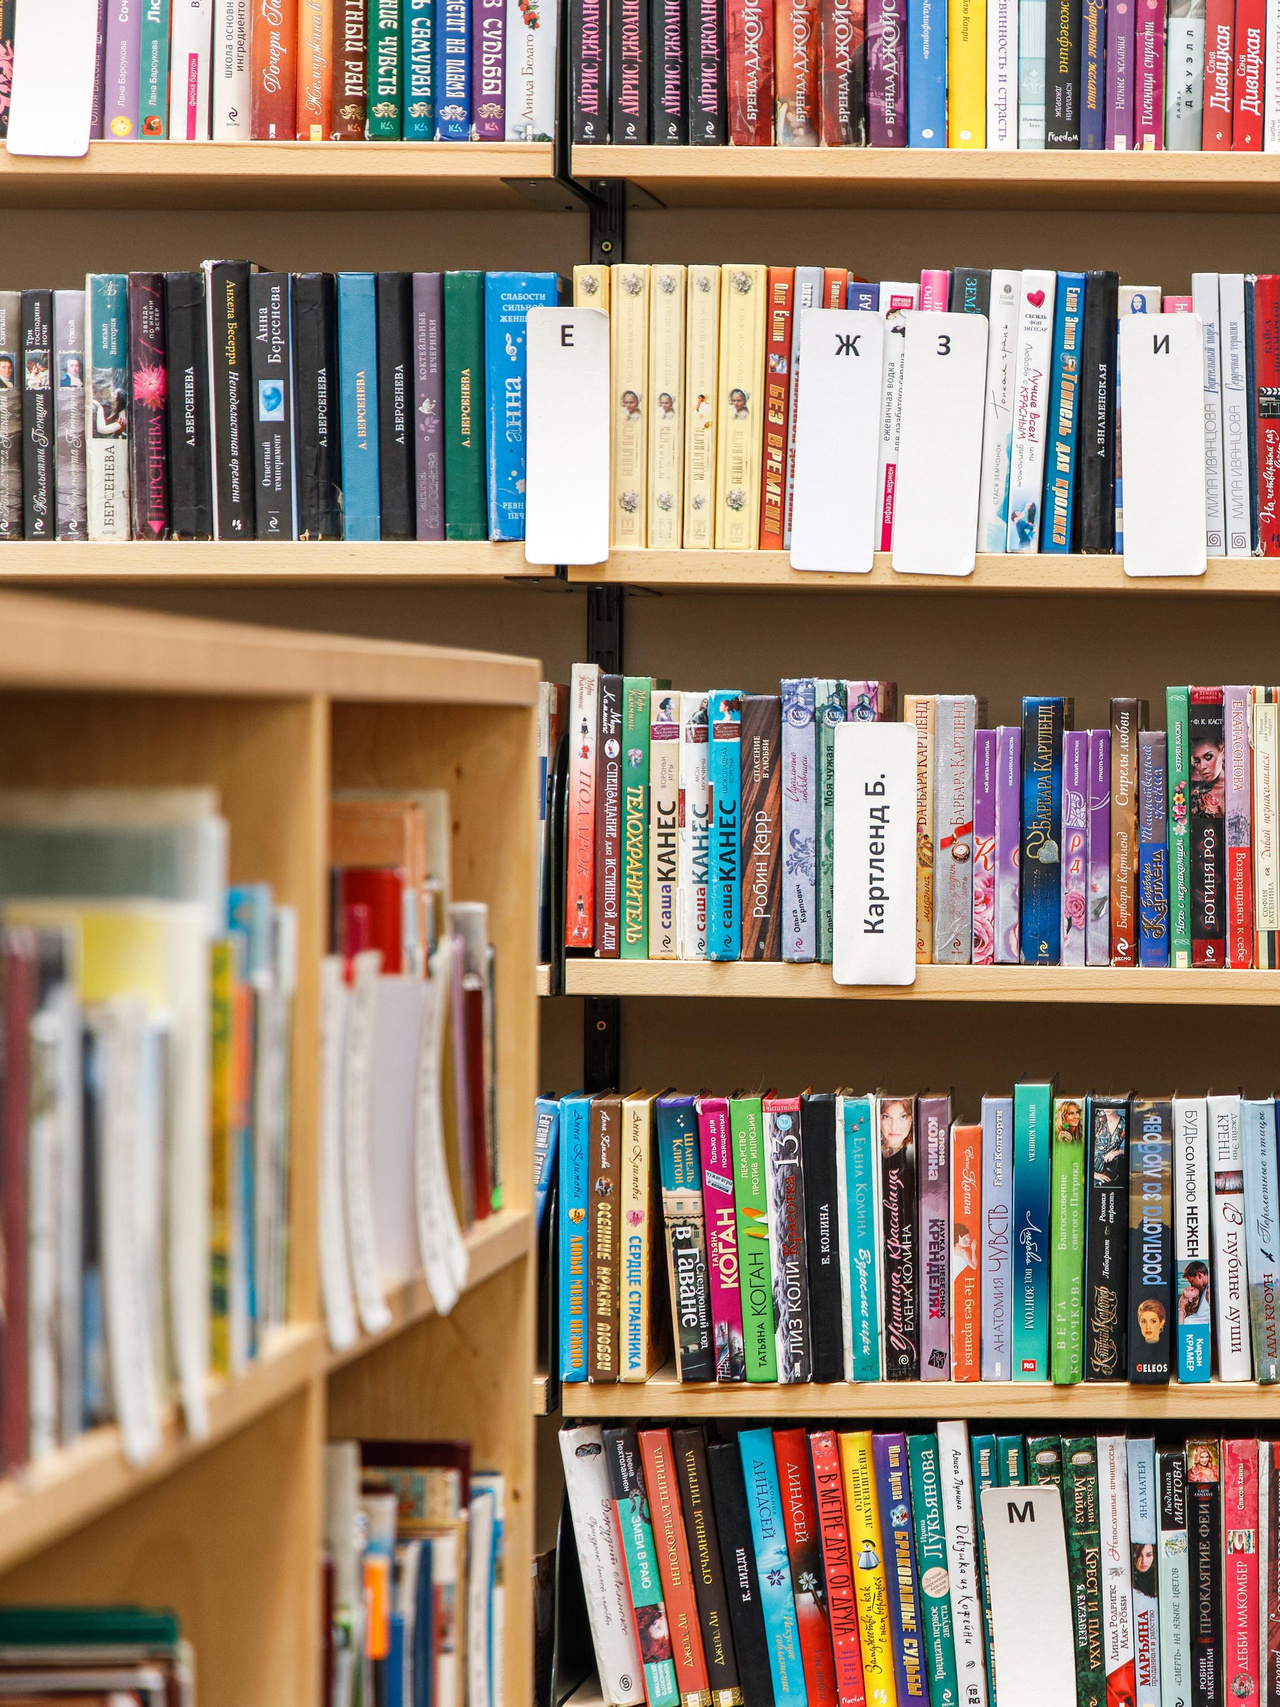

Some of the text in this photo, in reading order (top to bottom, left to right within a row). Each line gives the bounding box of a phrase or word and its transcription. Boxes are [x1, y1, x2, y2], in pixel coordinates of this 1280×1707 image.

[148, 40, 159, 106] Лана Барсукова
[189, 59, 198, 107] фиона бартон
[522, 34, 535, 120] Линда Белаго
[579, 64, 599, 115] АЙРИС
[745, 70, 757, 120] БРЕНДА
[1115, 36, 1126, 109] Ночные желания
[1143, 21, 1156, 125] Пленница страсти
[1237, 54, 1247, 77] Соня
[1241, 28, 1262, 115] Дивицкая
[256, 308, 267, 343] Анна
[268, 286, 282, 364] Берсенева
[561, 325, 574, 347] Е
[835, 335, 860, 356] Ж
[937, 336, 950, 355] З
[1153, 335, 1169, 354] И
[184, 367, 195, 446] А. БЕРСЕНЕВА
[461, 369, 470, 447] А. БЕРСЕНЕВА
[1097, 364, 1106, 457] А. ЗНАМЕНСКАЯ
[103, 445, 115, 526] БЕРСЕНЕВА
[765, 385, 783, 533] БЕЗ ВРЕМЕНИ
[884, 467, 894, 524] рафаэль жермен
[1116, 712, 1131, 806] Стрелы любви
[625, 785, 643, 943] ТЕЛОХРАНИТЕЛЬ
[656, 801, 676, 929] саша КАНЕС
[753, 811, 771, 918] Робин Карр
[864, 774, 889, 934] Картленд Б.
[1118, 832, 1129, 928] Барбара Картленд
[1204, 829, 1215, 924] БОГИНЯ РОЗ
[773, 1134, 799, 1255] Красотка 13
[820, 1204, 830, 1264] Е. КОЛИНА
[1138, 1116, 1166, 1286] расплата за любовь
[1186, 1206, 1198, 1257] НЕЖЕН
[717, 1208, 738, 1288] КОГАН
[628, 1236, 641, 1369] СЕРДЦЕ СТРАННИКА
[786, 1261, 804, 1355] ЛИЗ КОЛИ
[1136, 1364, 1168, 1373] GELEOS
[685, 1450, 713, 1584] ОТЧАЯННАЯ ТИГРИЦА
[919, 1449, 945, 1558] Лукьянова
[1007, 1501, 1035, 1523] М
[1137, 1461, 1148, 1518] ЯНА МАТЕЙ
[735, 1548, 751, 1601] К. ЛИДДИ
[1198, 1503, 1211, 1634] ПРОКЛЯТИЕ ФЕИ
[1139, 1610, 1151, 1686] МАРЬЯНА
[1236, 1561, 1248, 1670] ДЕББИ МАКОМБЕР
